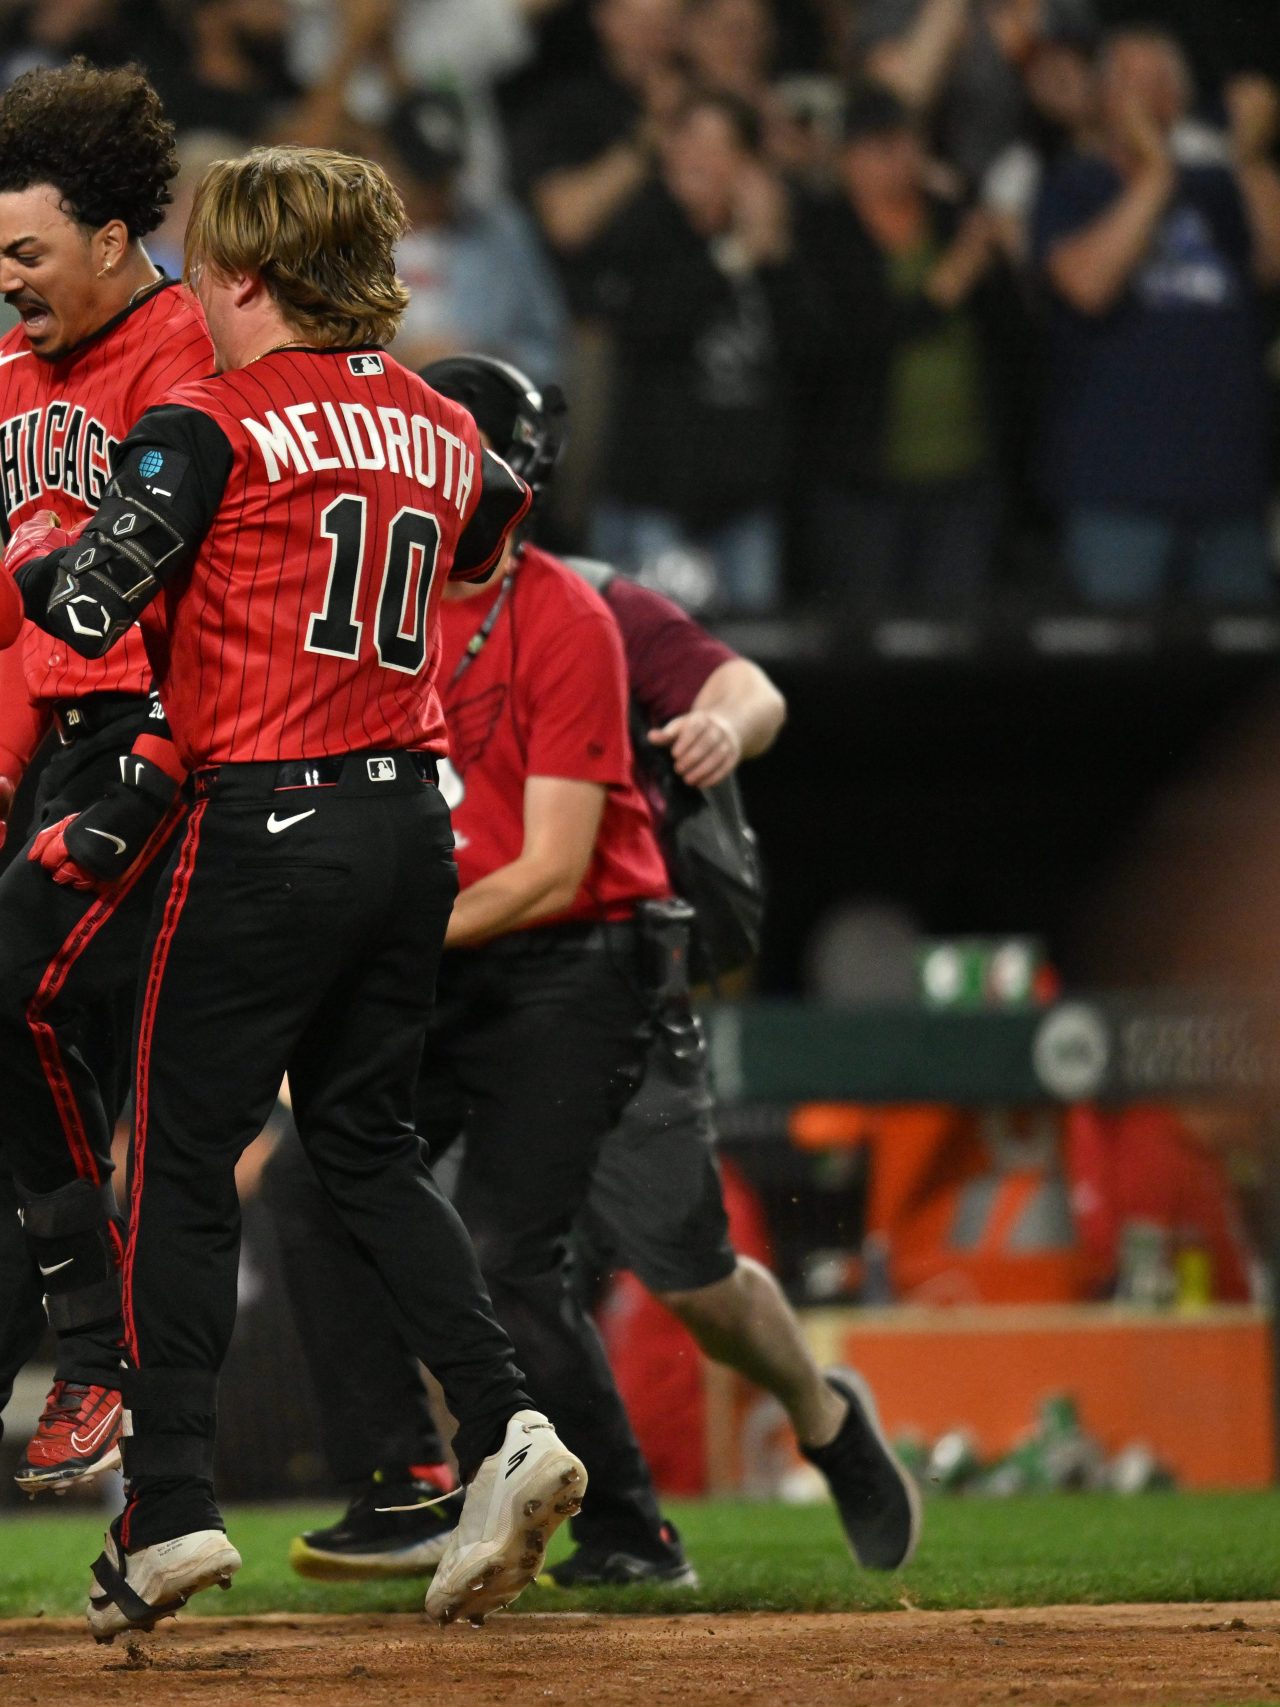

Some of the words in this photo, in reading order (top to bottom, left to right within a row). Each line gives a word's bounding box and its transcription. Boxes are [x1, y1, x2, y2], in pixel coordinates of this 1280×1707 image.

[240, 401, 475, 520] MEIDROTH
[303, 492, 442, 676] 10
[66, 708, 81, 726] 20
[148, 701, 166, 720] 20
